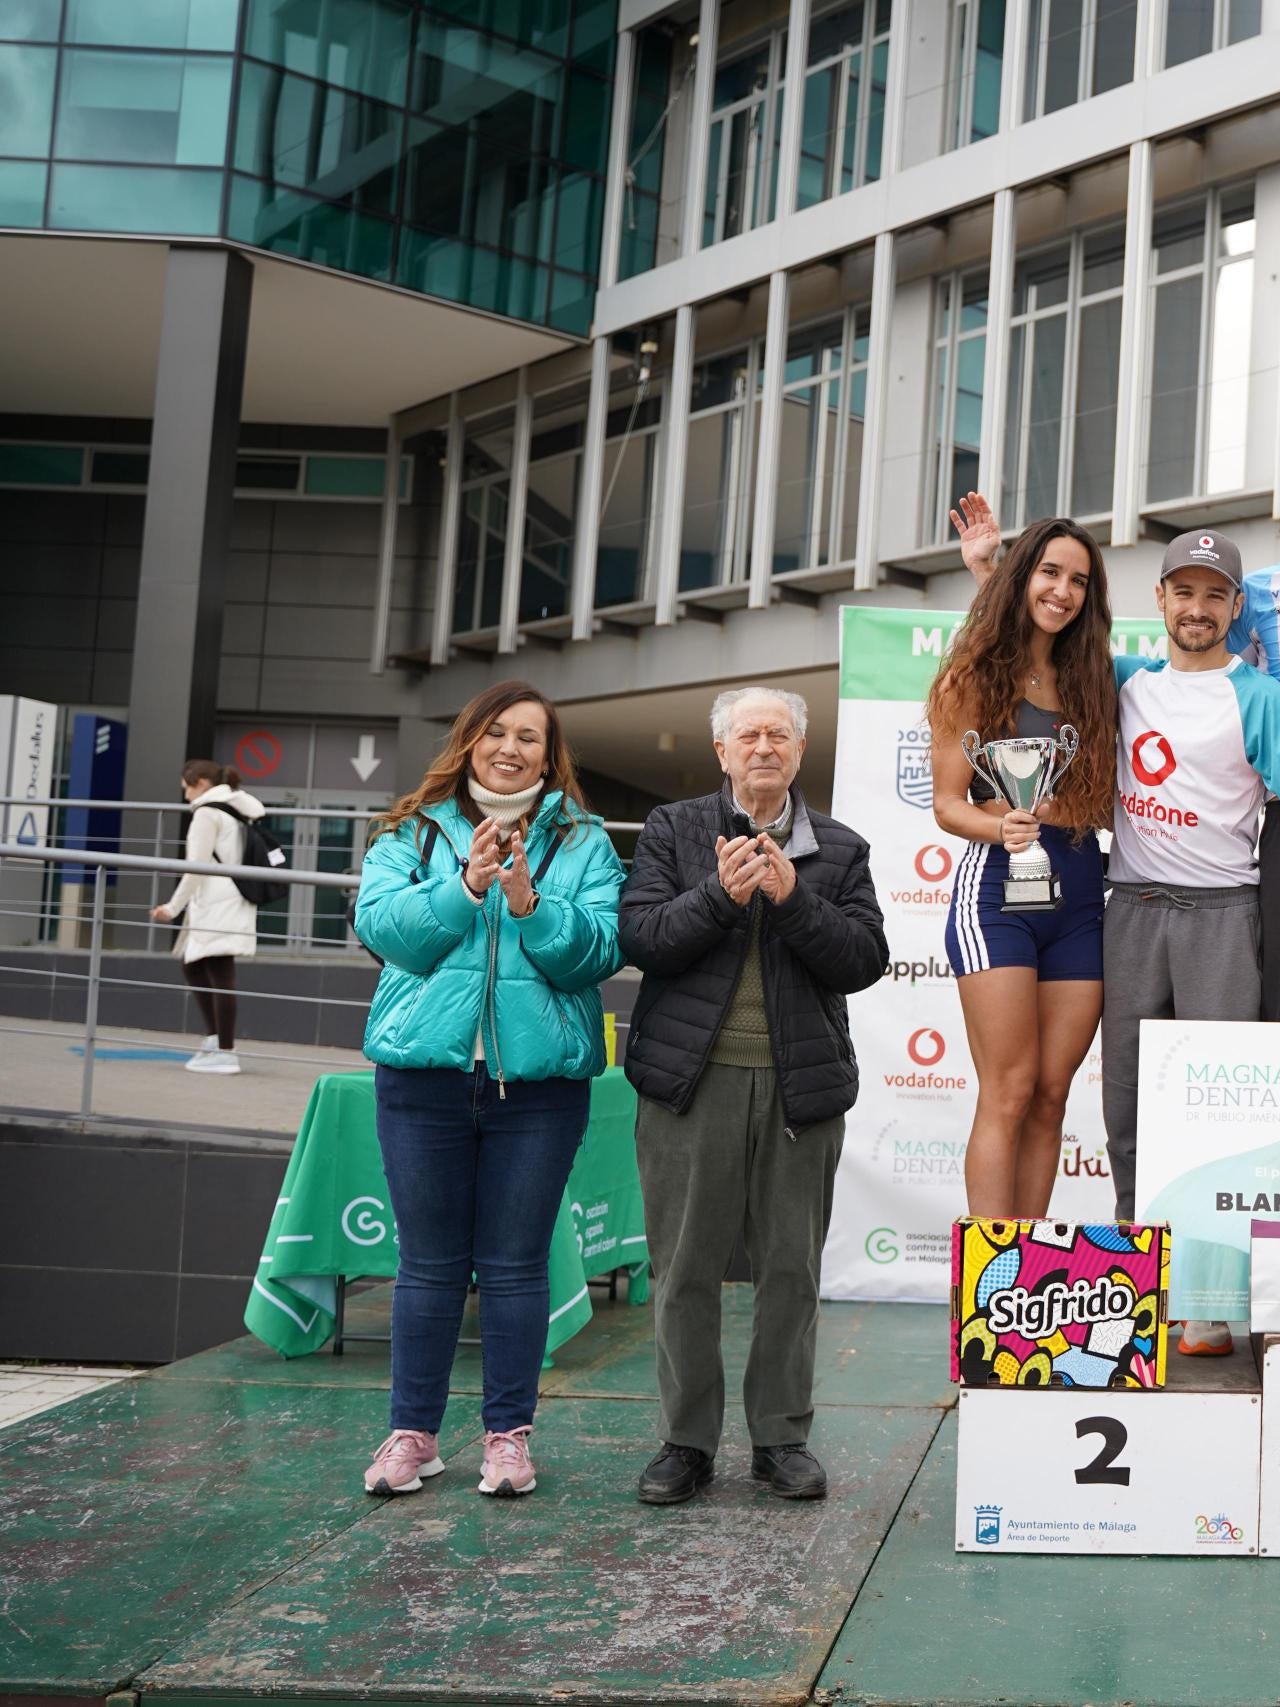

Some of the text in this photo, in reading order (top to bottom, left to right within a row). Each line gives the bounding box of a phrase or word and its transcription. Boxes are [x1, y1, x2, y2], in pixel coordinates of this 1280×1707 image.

[26, 711, 44, 799] Dedalus
[884, 1073, 967, 1089] vodafone
[1255, 1166, 1267, 1178] El
[992, 1278, 1131, 1337] Sigfrido
[1074, 1416, 1131, 1487] 2
[1007, 1518, 1137, 1532] Ayuntamiento de Málaga
[1007, 1533, 1071, 1543] Área de Deporte
